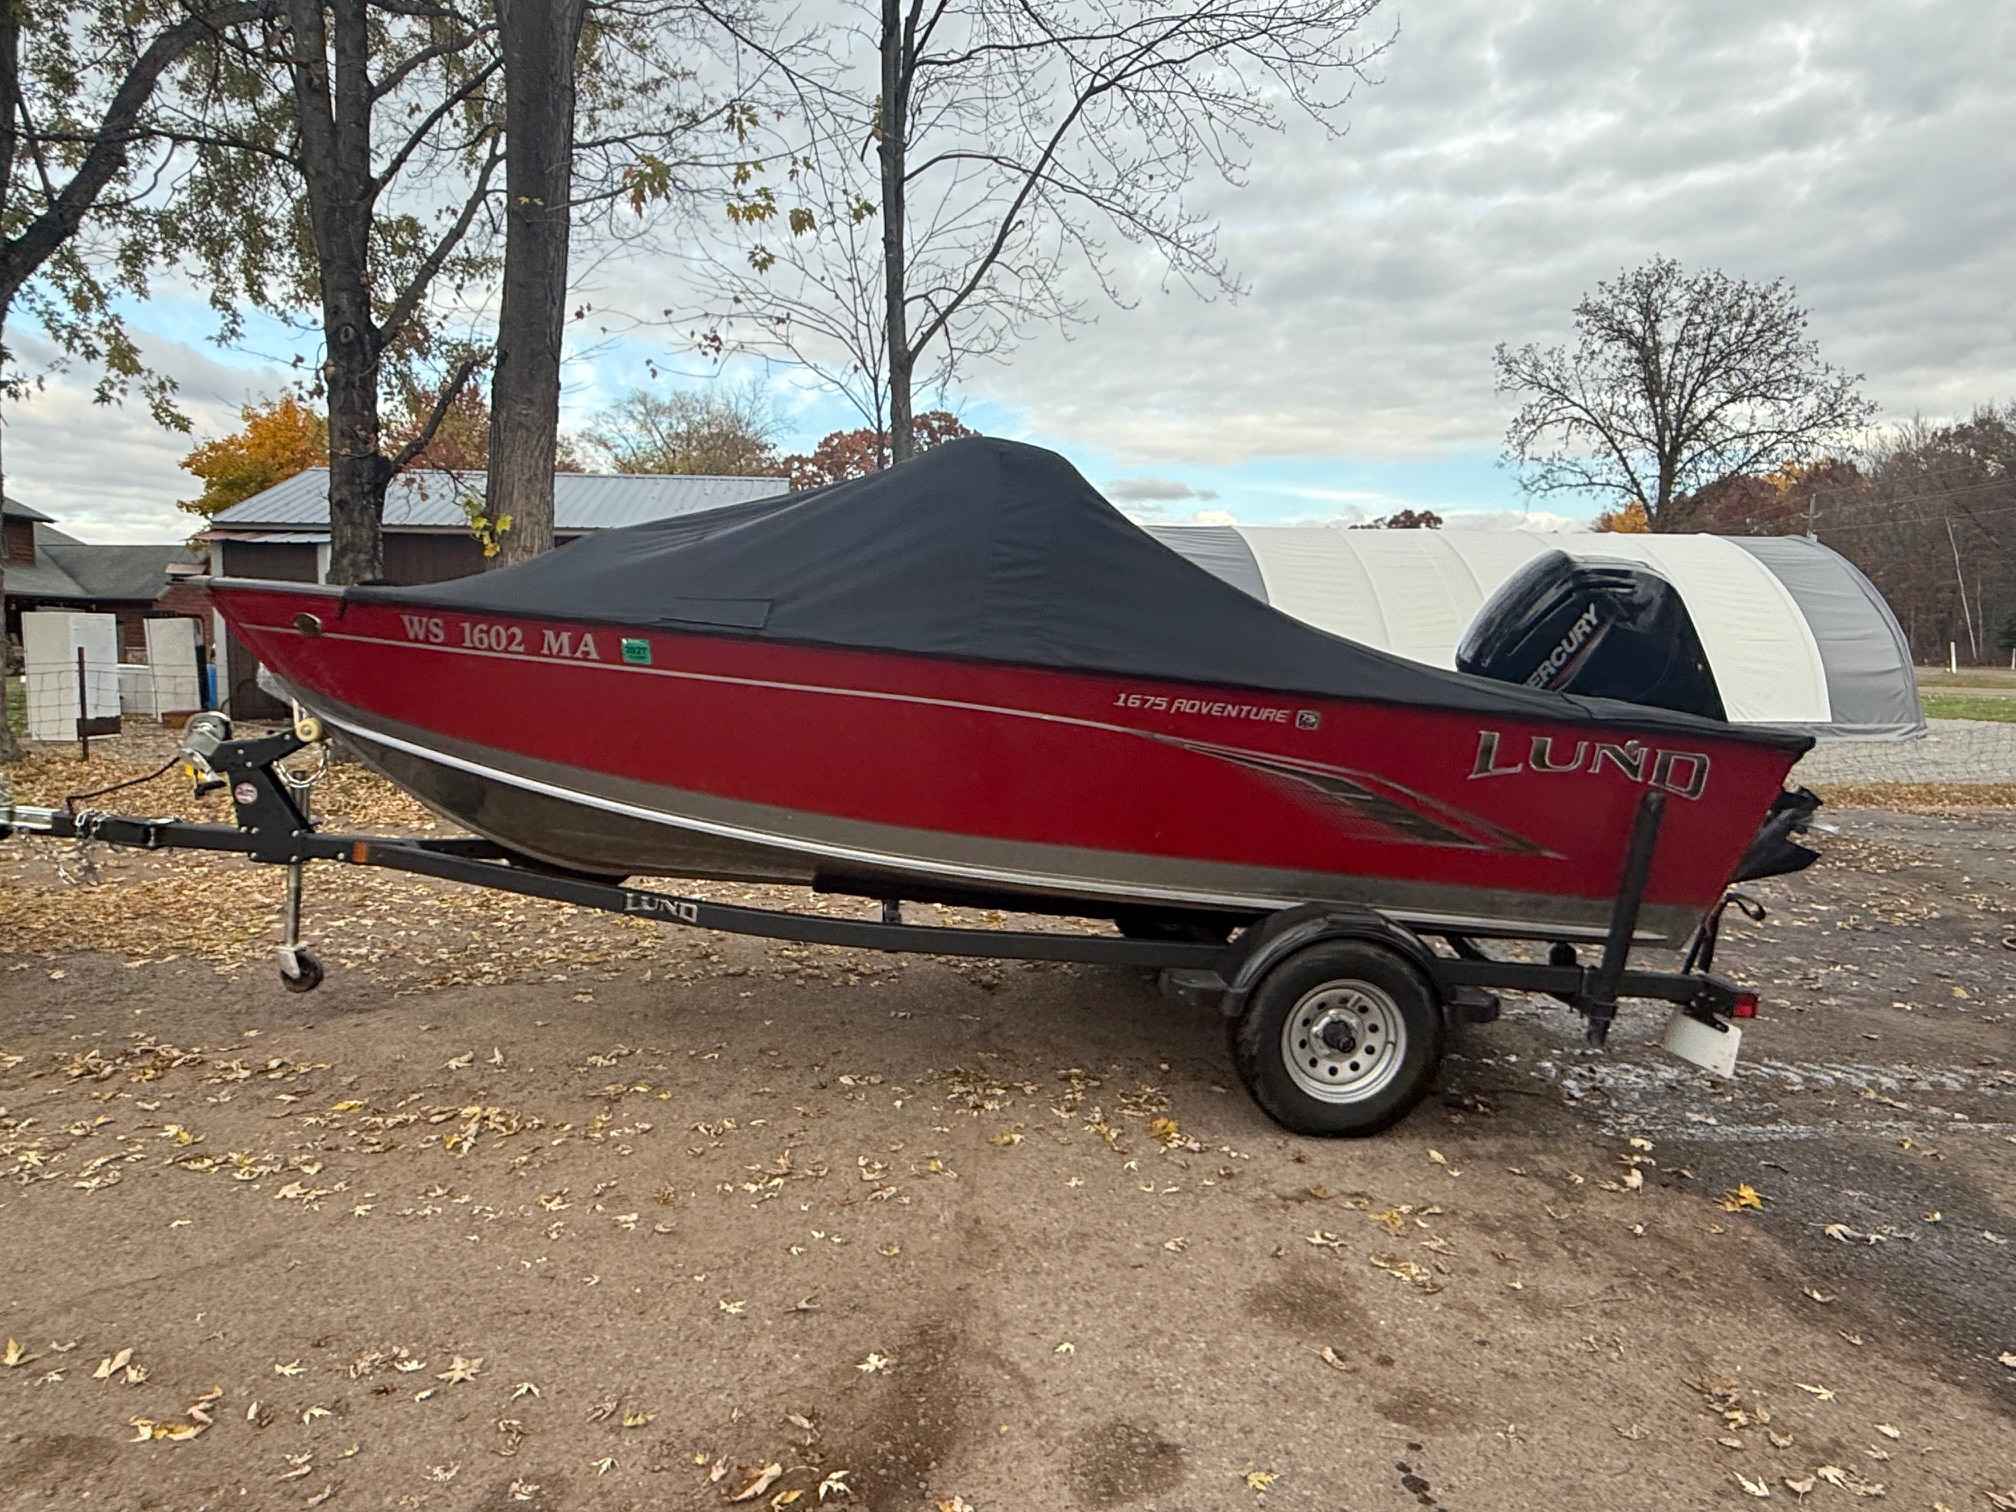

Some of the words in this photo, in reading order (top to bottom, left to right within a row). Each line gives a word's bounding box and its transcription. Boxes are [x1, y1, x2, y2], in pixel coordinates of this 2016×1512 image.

[402, 614, 444, 643] WS
[461, 621, 525, 653] 1602
[541, 629, 600, 660] MA
[1523, 602, 1598, 689] ERCURY
[1114, 693, 1168, 710] 1675
[1170, 699, 1290, 723] ADVENTURE
[1467, 730, 1711, 800] LUND
[624, 892, 698, 923] LUND
